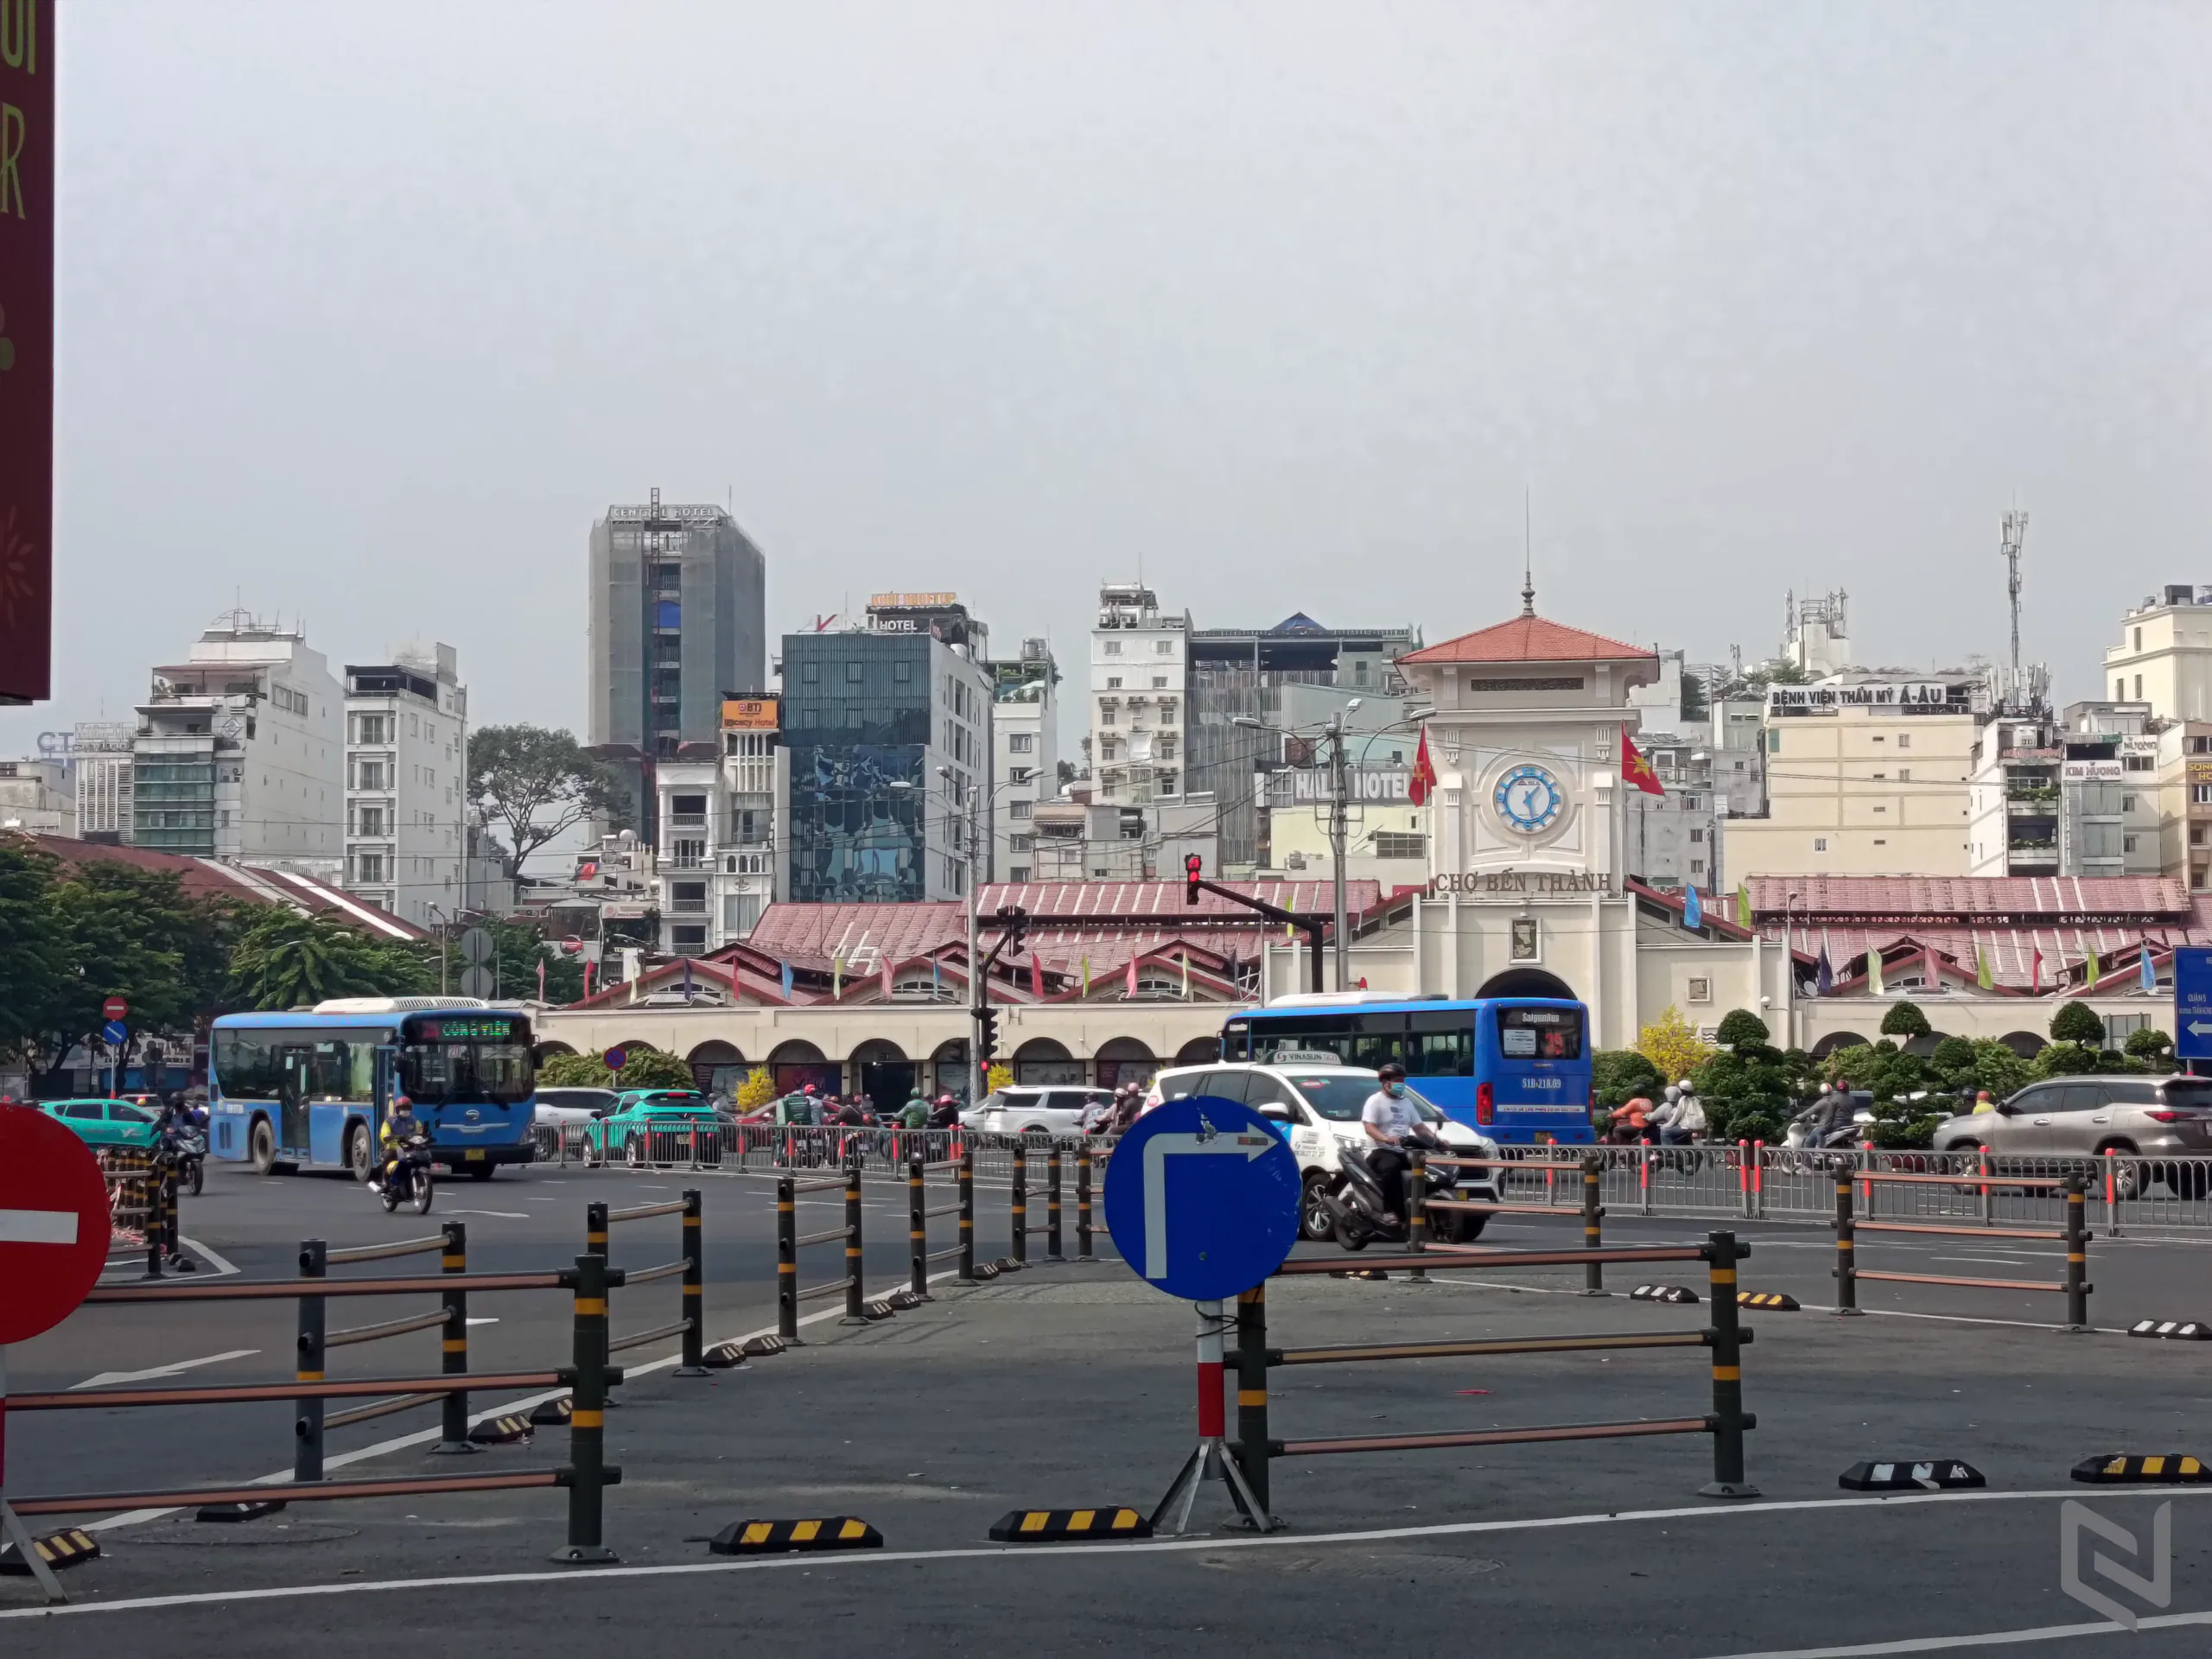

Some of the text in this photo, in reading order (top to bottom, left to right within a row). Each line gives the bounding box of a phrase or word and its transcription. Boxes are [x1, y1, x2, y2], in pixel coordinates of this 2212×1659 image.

[674, 506, 714, 517] HOTEL
[880, 620, 918, 631] HOTEL
[2187, 762, 2212, 772] SON
